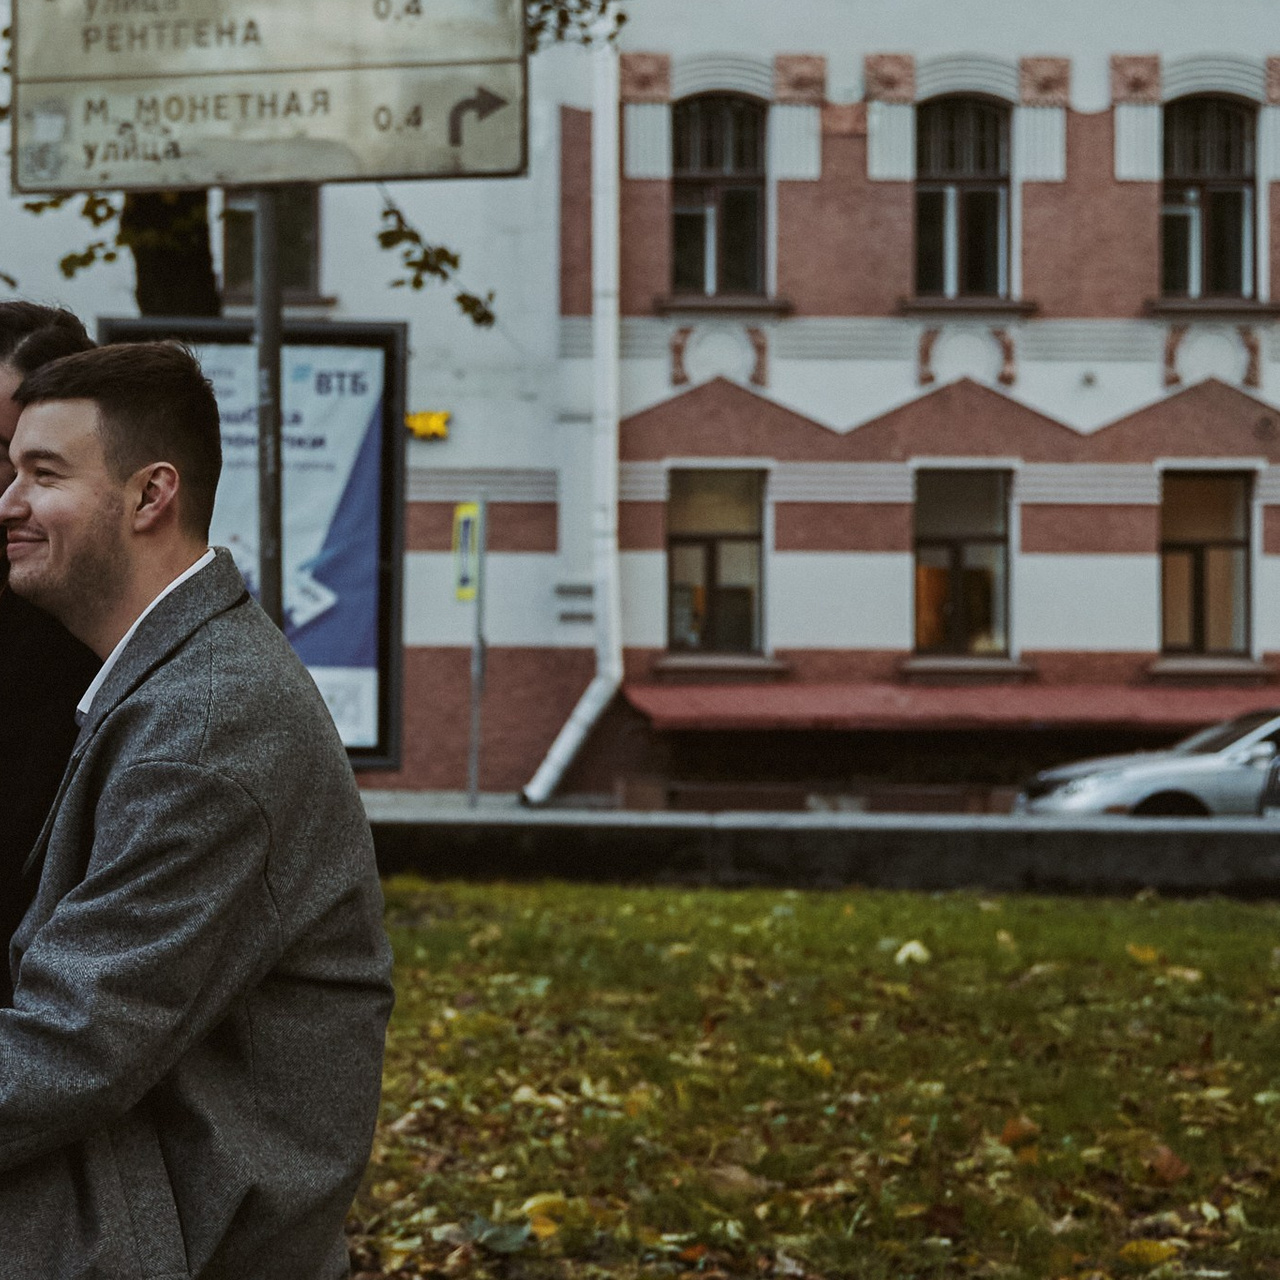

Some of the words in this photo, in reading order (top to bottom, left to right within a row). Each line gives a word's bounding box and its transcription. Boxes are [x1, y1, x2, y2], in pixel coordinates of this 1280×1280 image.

[82, 19, 262, 55] РЕНТГЕНА
[135, 89, 332, 123] МОНЕТНАЯ
[83, 139, 182, 170] улица
[316, 371, 369, 397] ВТБ
